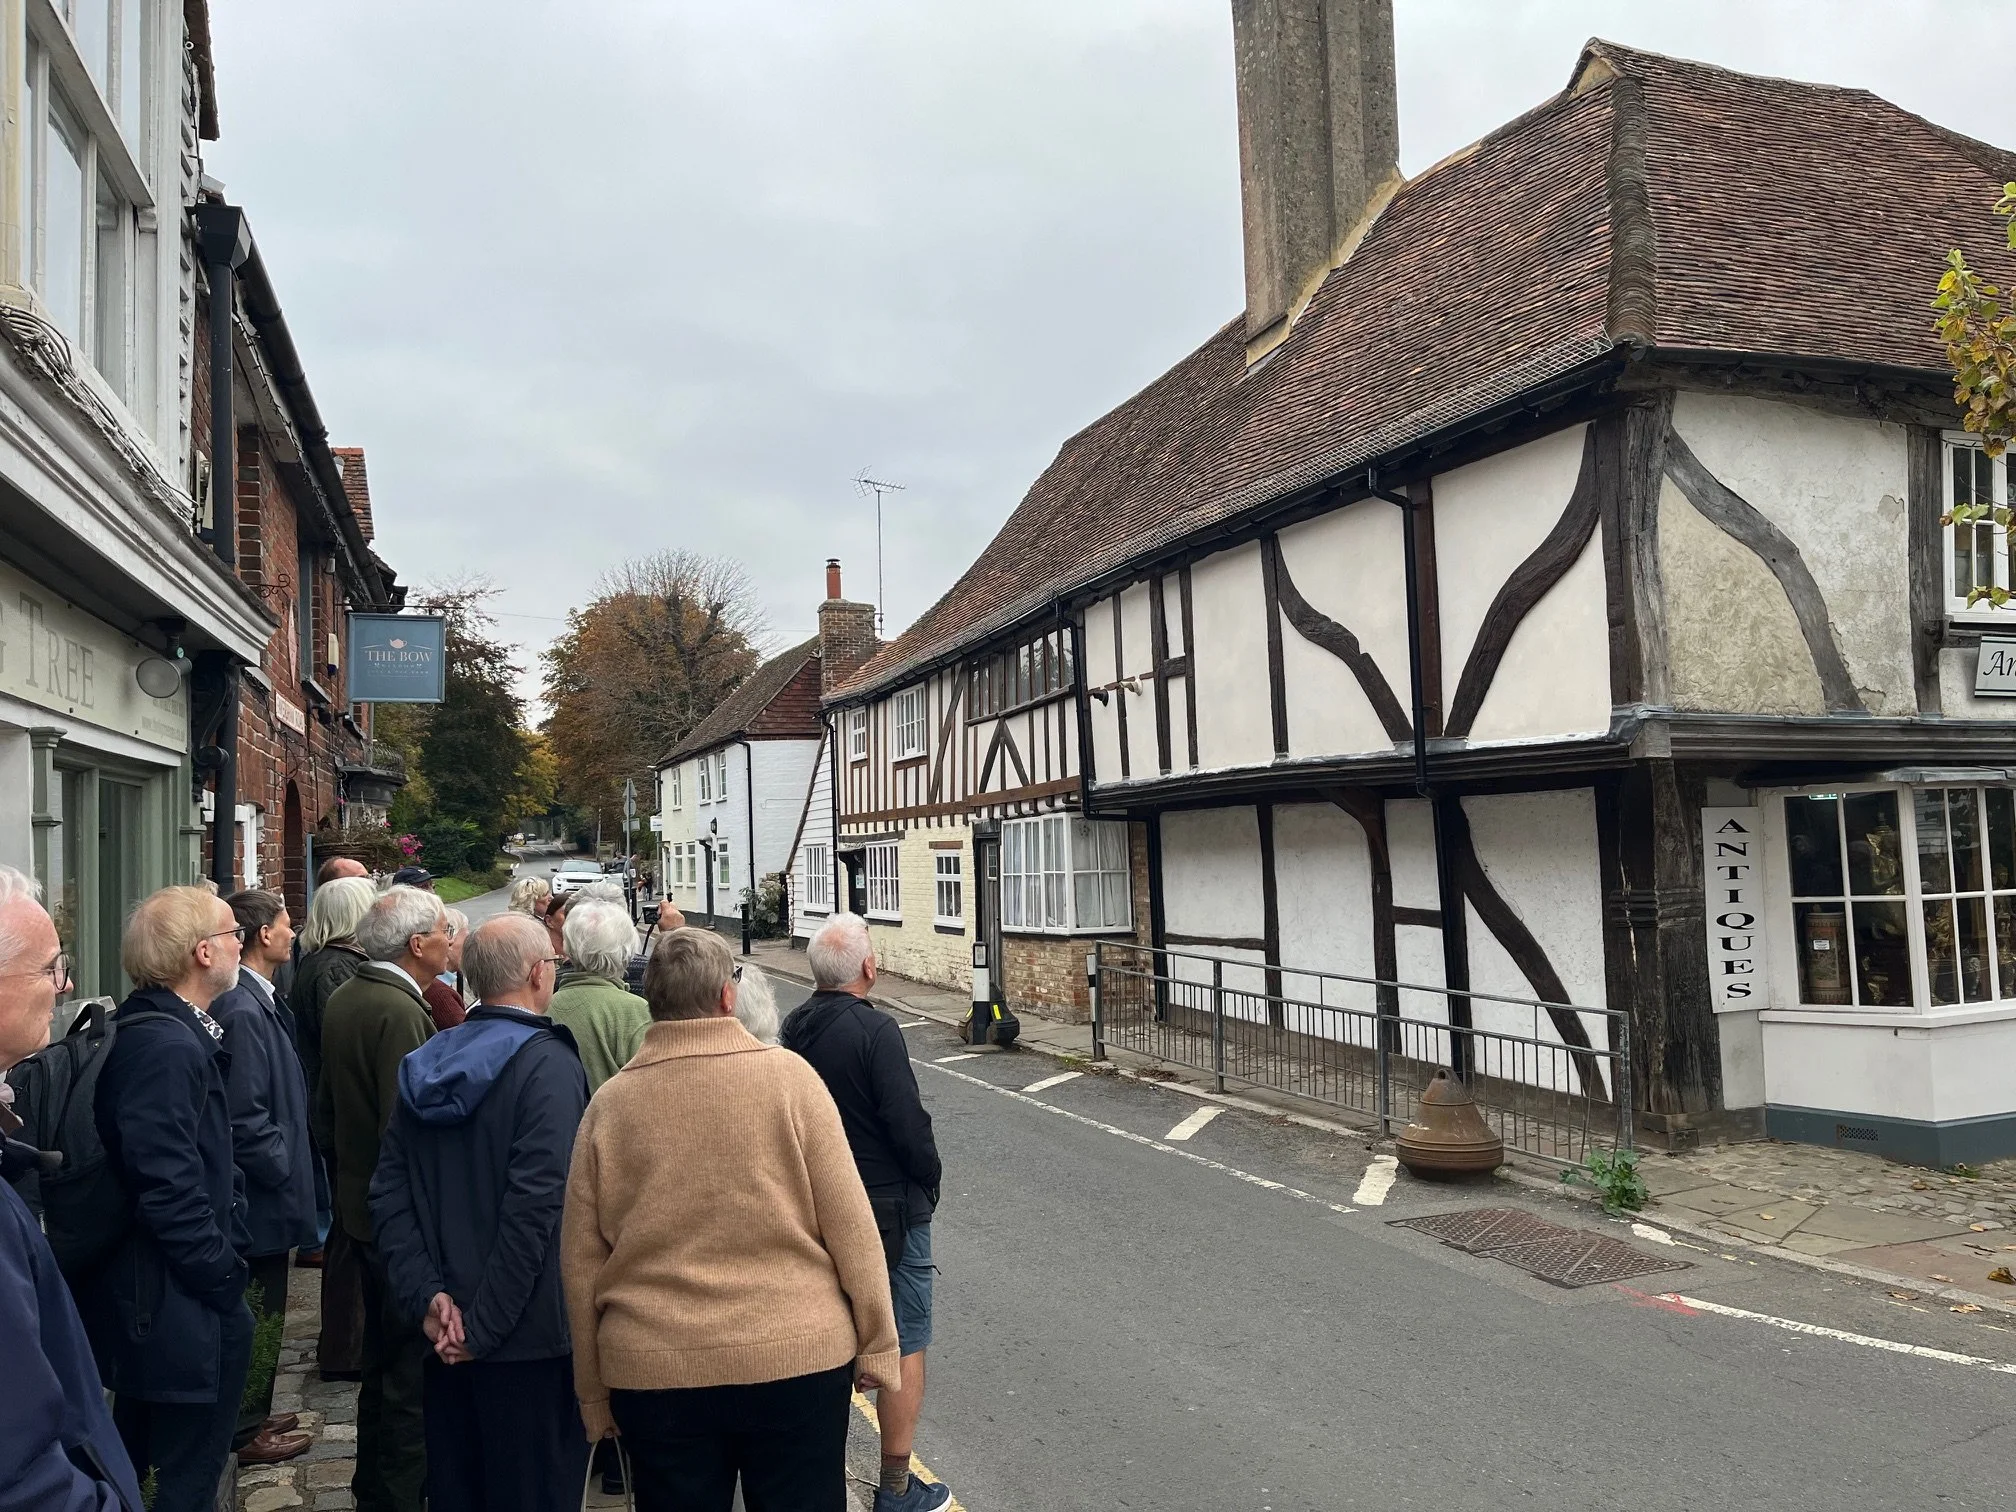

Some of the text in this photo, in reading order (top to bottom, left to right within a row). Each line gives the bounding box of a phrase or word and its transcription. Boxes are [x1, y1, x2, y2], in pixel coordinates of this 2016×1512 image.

[19, 591, 95, 710] TREE
[365, 650, 433, 662] THE BOW
[1714, 818, 1755, 999] ANTIQUES
